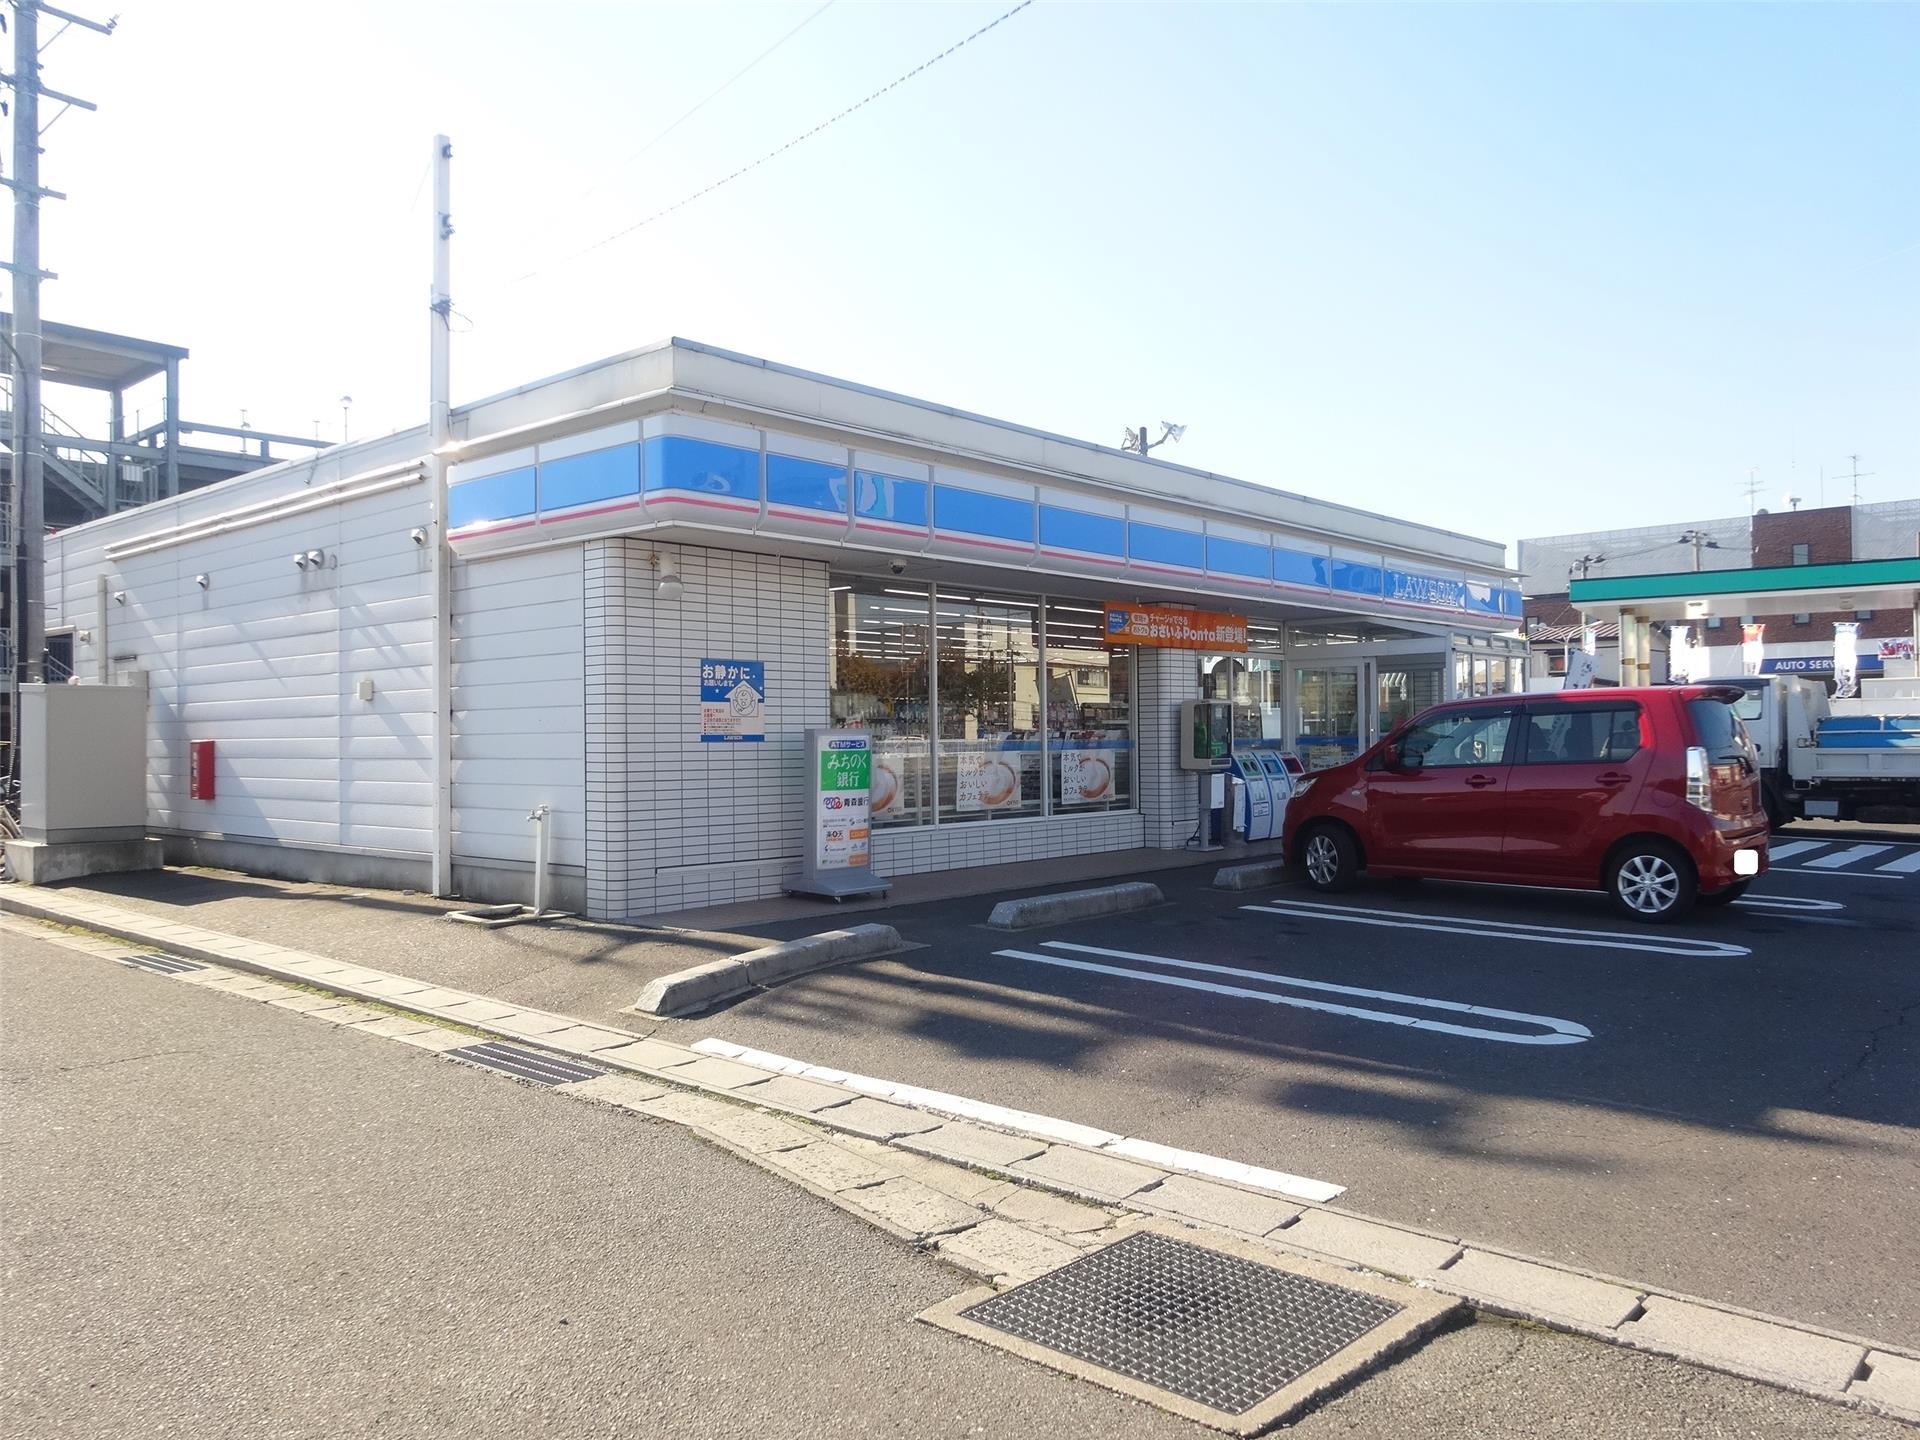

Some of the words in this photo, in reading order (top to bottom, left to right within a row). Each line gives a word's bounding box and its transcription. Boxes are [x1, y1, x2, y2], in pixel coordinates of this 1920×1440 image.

[702, 664, 750, 680] お静かに
[1775, 661, 1806, 670] AUTO
[1809, 659, 1835, 669] SERV
[827, 753, 867, 769] みちのく
[836, 771, 859, 787] 銀行
[959, 780, 987, 789] おいしい
